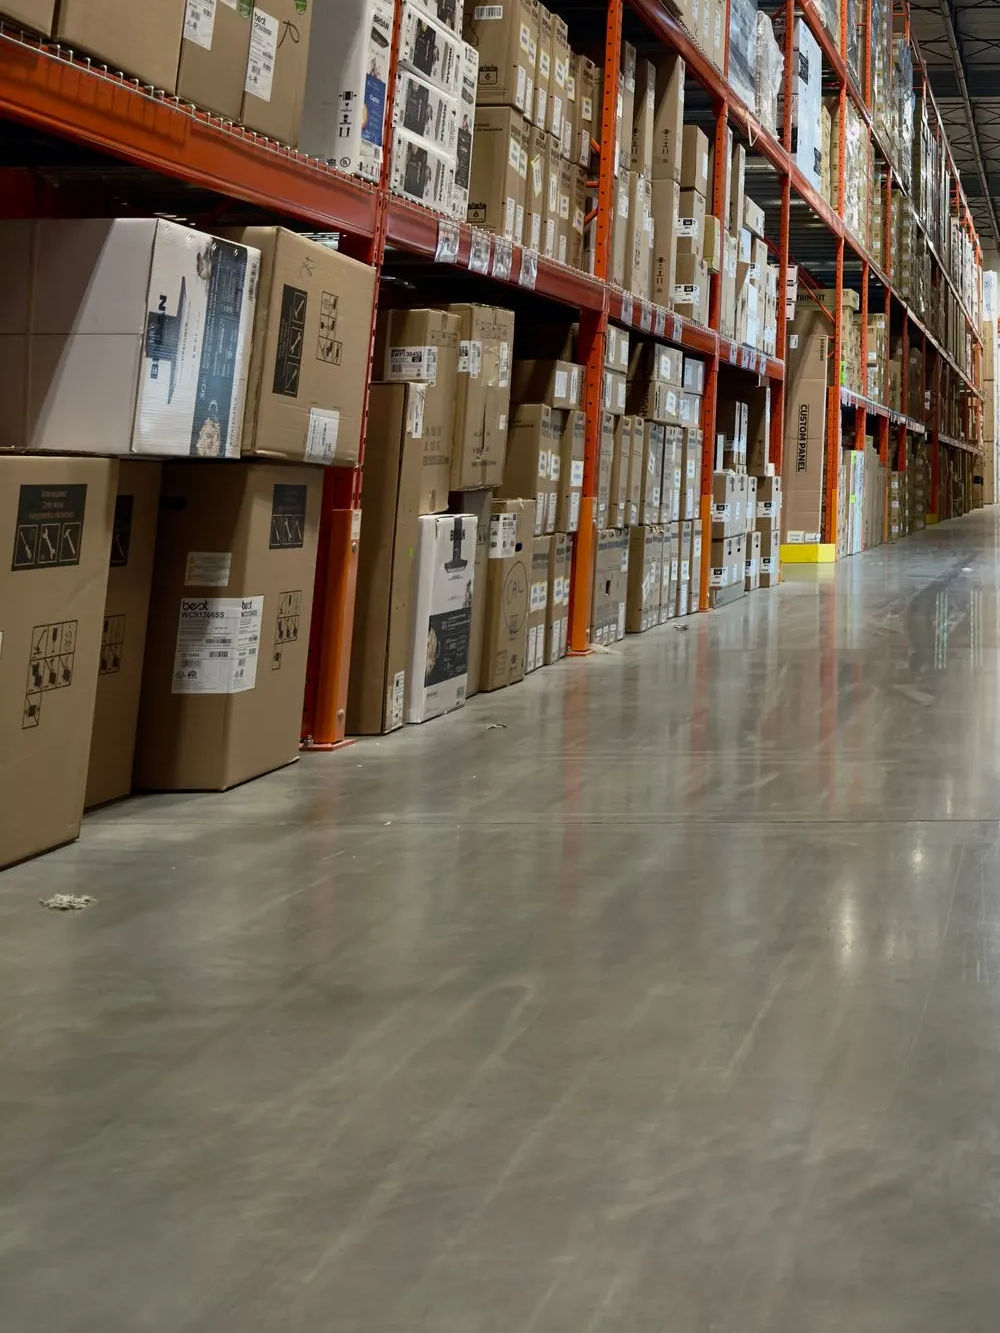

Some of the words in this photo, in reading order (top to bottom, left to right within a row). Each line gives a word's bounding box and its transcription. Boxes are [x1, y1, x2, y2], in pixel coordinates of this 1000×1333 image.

[373, 14, 390, 30] BROAN
[445, 47, 453, 85] BROAN
[438, 164, 446, 202] BROAN
[800, 404, 808, 441] CUSTOM
[798, 442, 806, 470] PANEL
[183, 600, 208, 611] best
